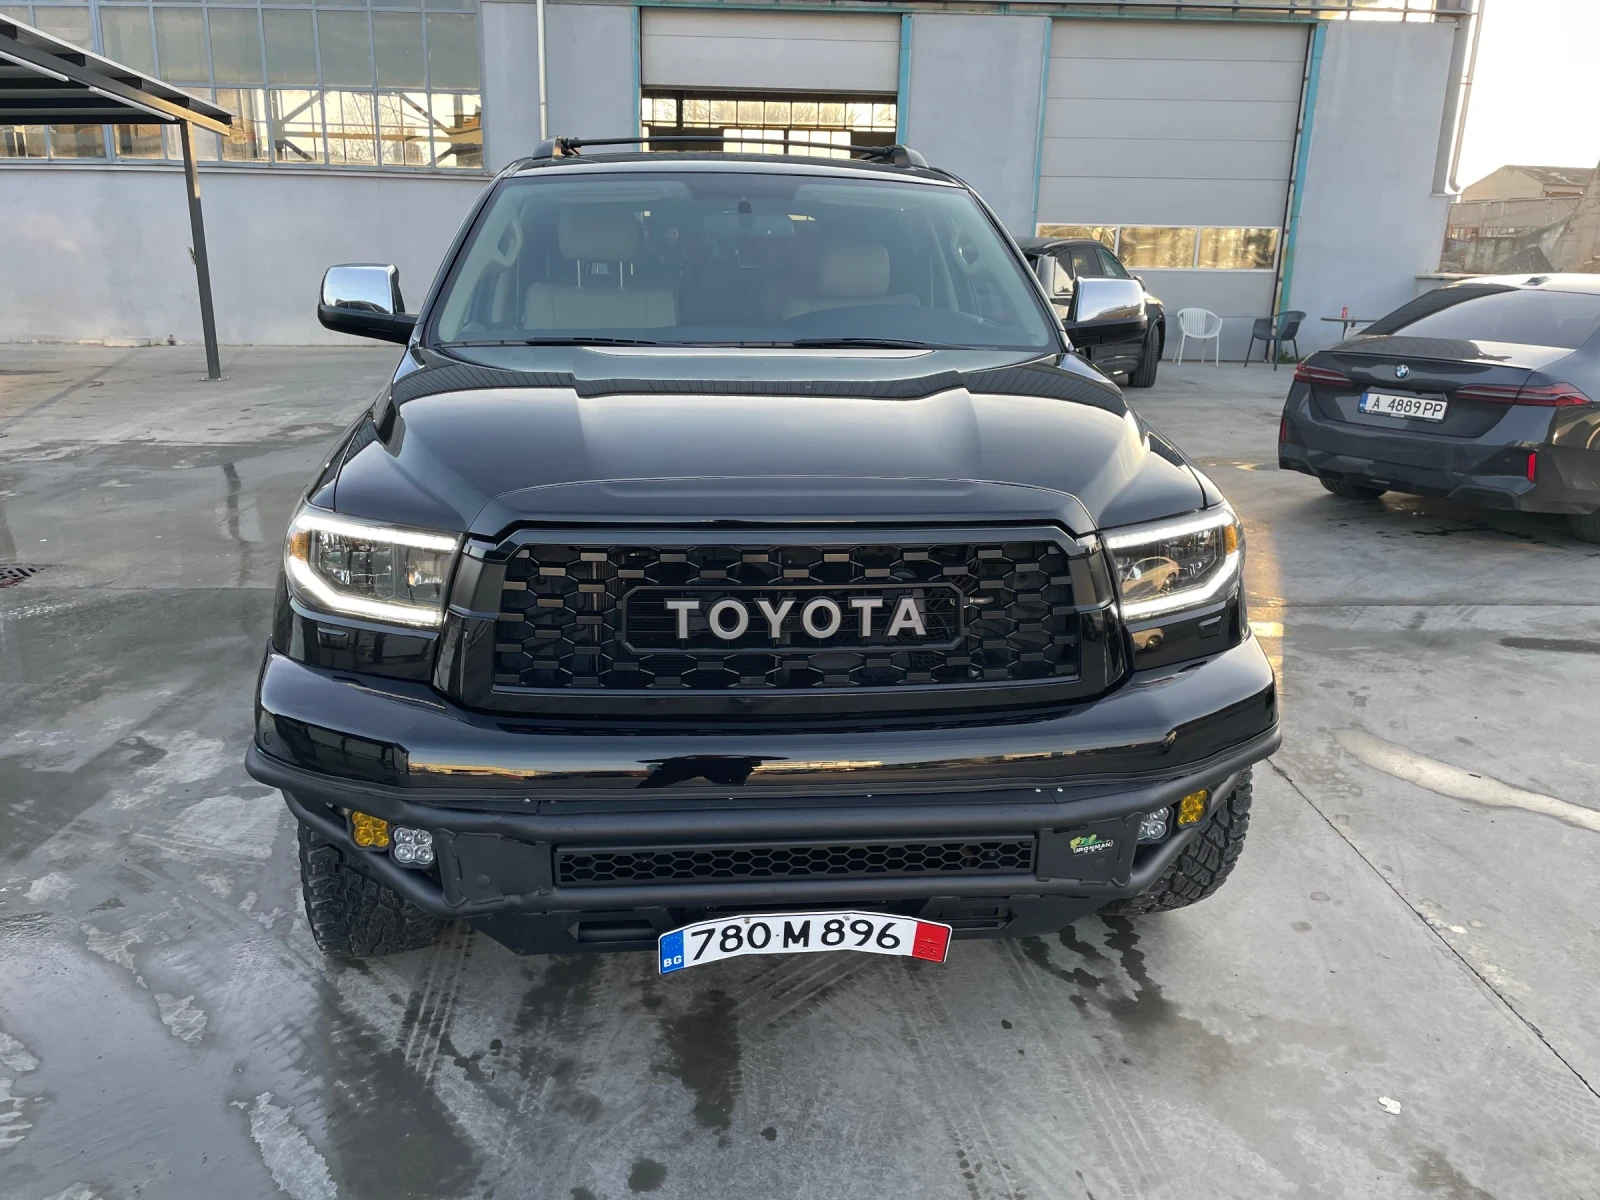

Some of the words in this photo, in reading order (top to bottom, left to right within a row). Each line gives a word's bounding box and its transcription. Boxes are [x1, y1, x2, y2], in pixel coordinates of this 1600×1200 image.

[665, 597, 927, 640] TOYOTA
[1075, 842, 1111, 852] IRONMAN
[691, 921, 772, 961] 780
[783, 920, 811, 948] M
[820, 919, 901, 950] 896
[663, 955, 682, 968] BG
